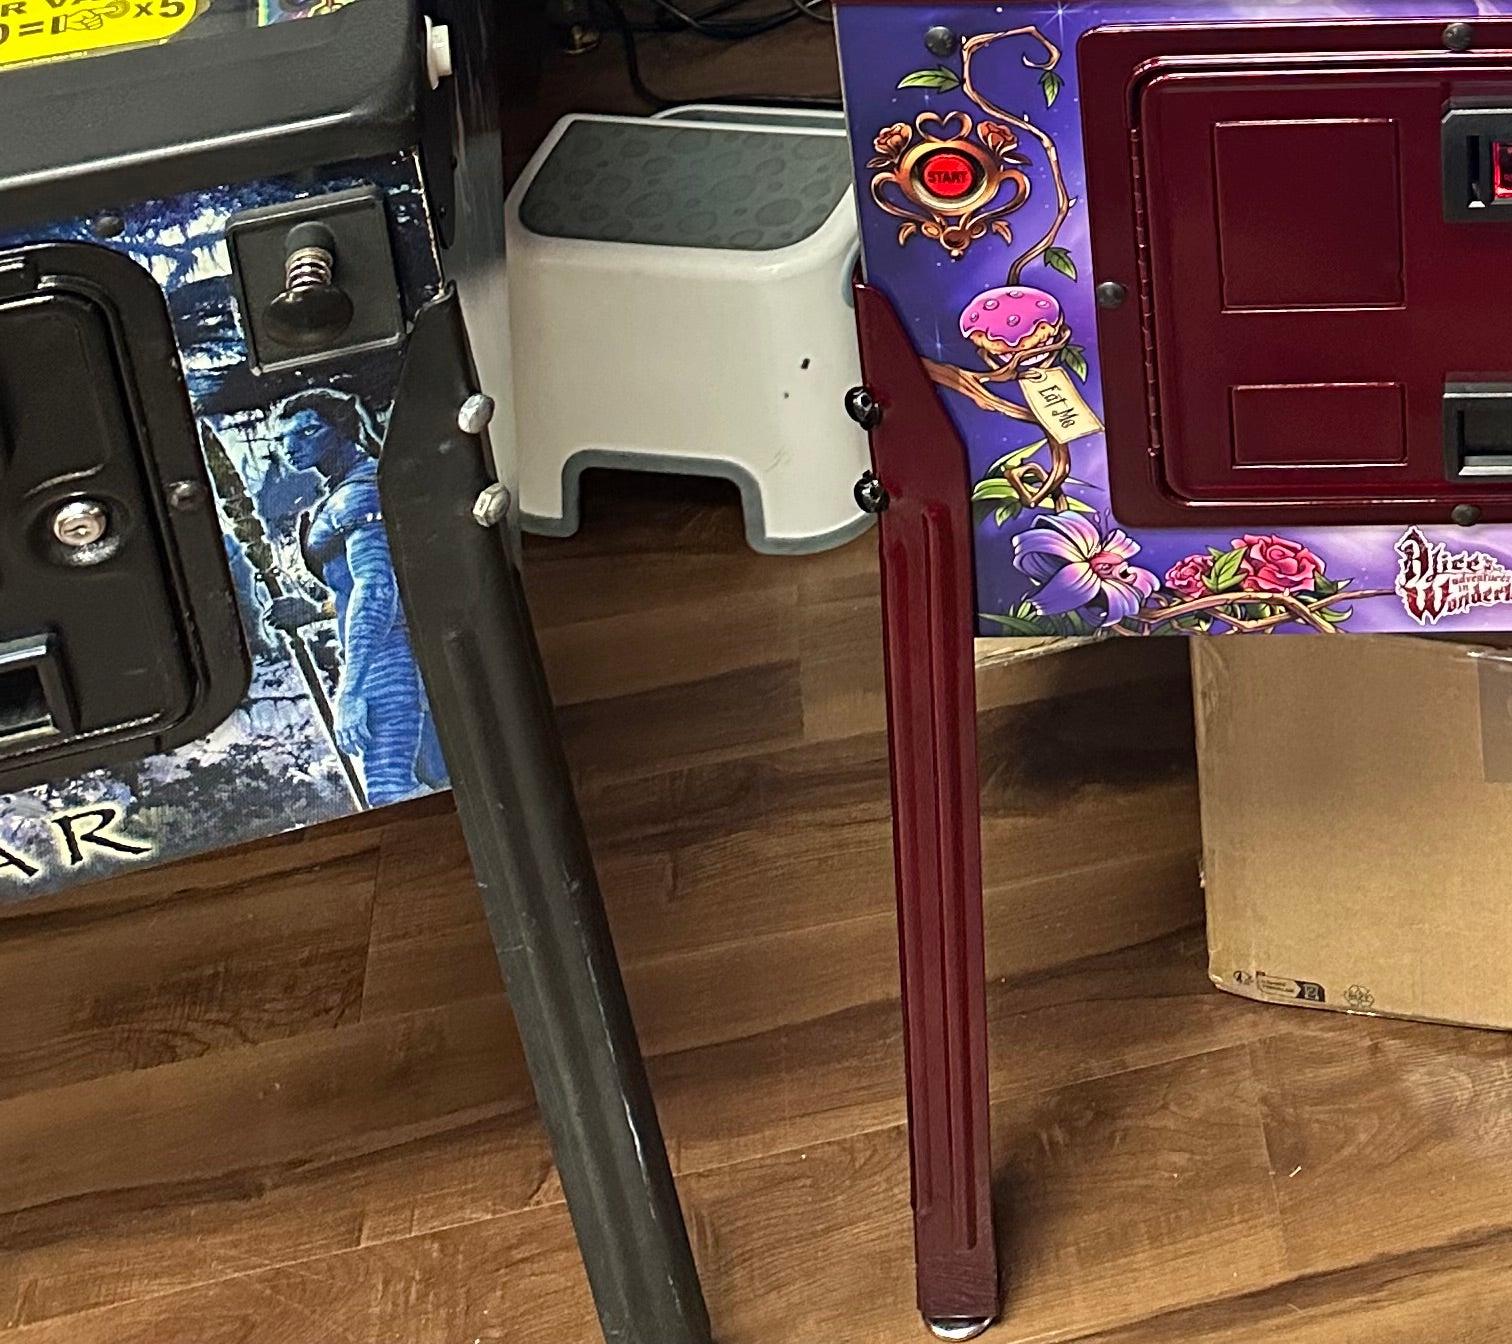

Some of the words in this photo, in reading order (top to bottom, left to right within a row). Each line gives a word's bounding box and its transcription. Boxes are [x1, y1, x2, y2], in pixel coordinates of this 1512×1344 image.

[927, 171, 967, 183] START
[1038, 384, 1068, 409] Eat
[1052, 406, 1075, 428] Me
[1452, 573, 1512, 585] adventures
[1458, 583, 1469, 592] in
